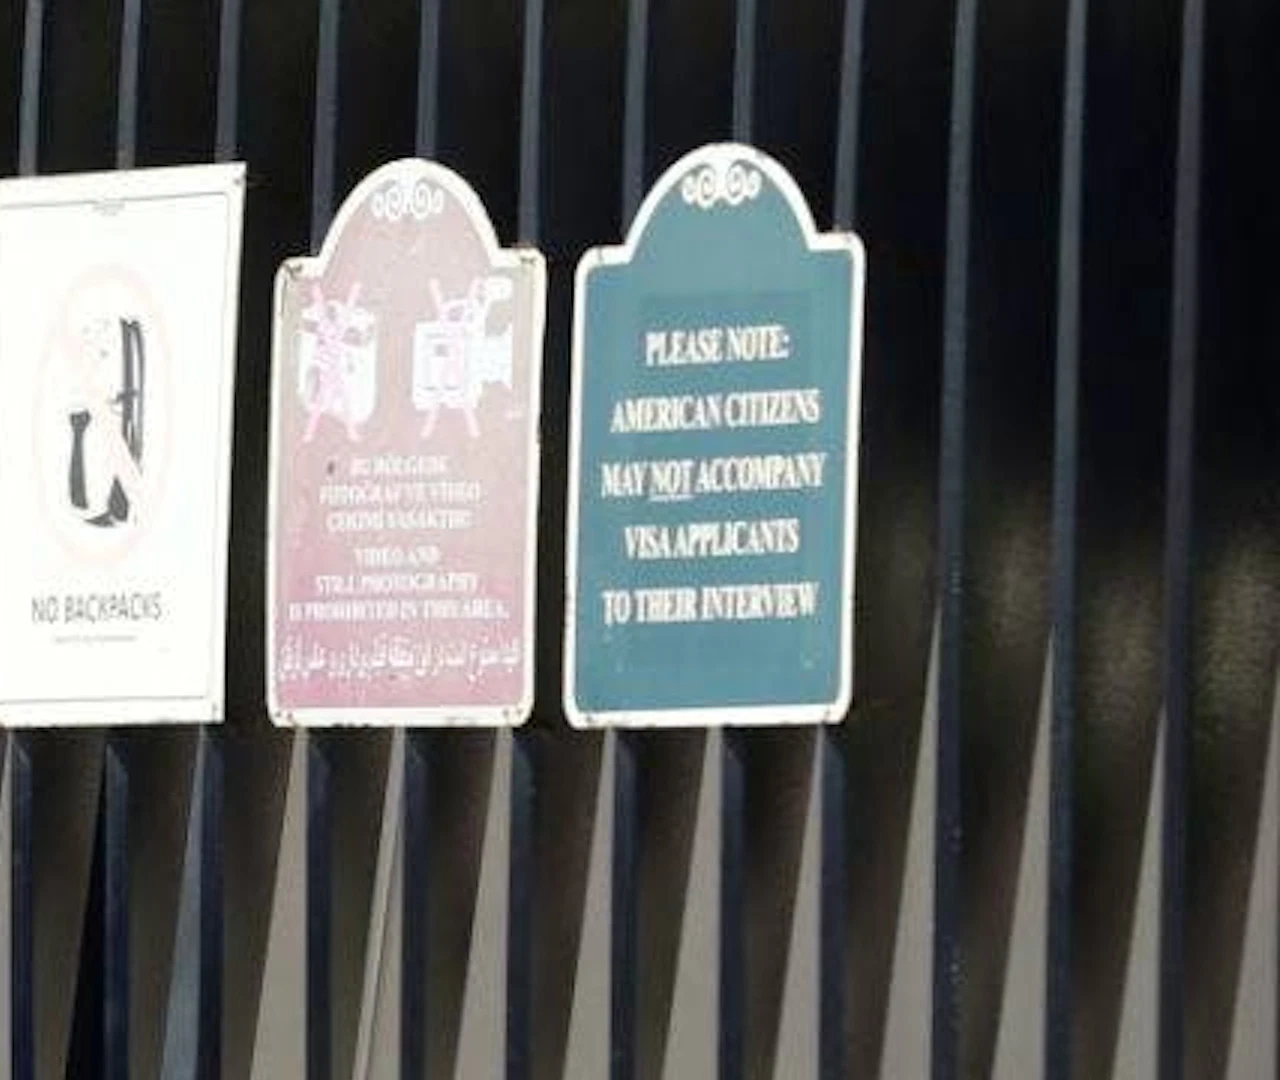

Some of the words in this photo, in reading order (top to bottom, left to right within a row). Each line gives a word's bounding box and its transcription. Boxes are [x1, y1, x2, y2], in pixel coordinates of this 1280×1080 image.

[646, 328, 724, 366] PLEASE
[727, 325, 789, 361] NOTE:
[610, 393, 722, 433] AMERICAN
[724, 388, 820, 428] CITIZENS
[601, 461, 649, 498] MAY
[649, 460, 694, 500] NOT
[695, 452, 827, 494] ACCOMPANY
[624, 524, 671, 559] VISA
[671, 518, 800, 558] APPLICANTS
[31, 597, 59, 625] NO
[64, 592, 162, 625] BACKPACKS
[601, 590, 631, 627] TO
[633, 587, 697, 623] THEIR
[700, 582, 820, 621] INTERVIEW
